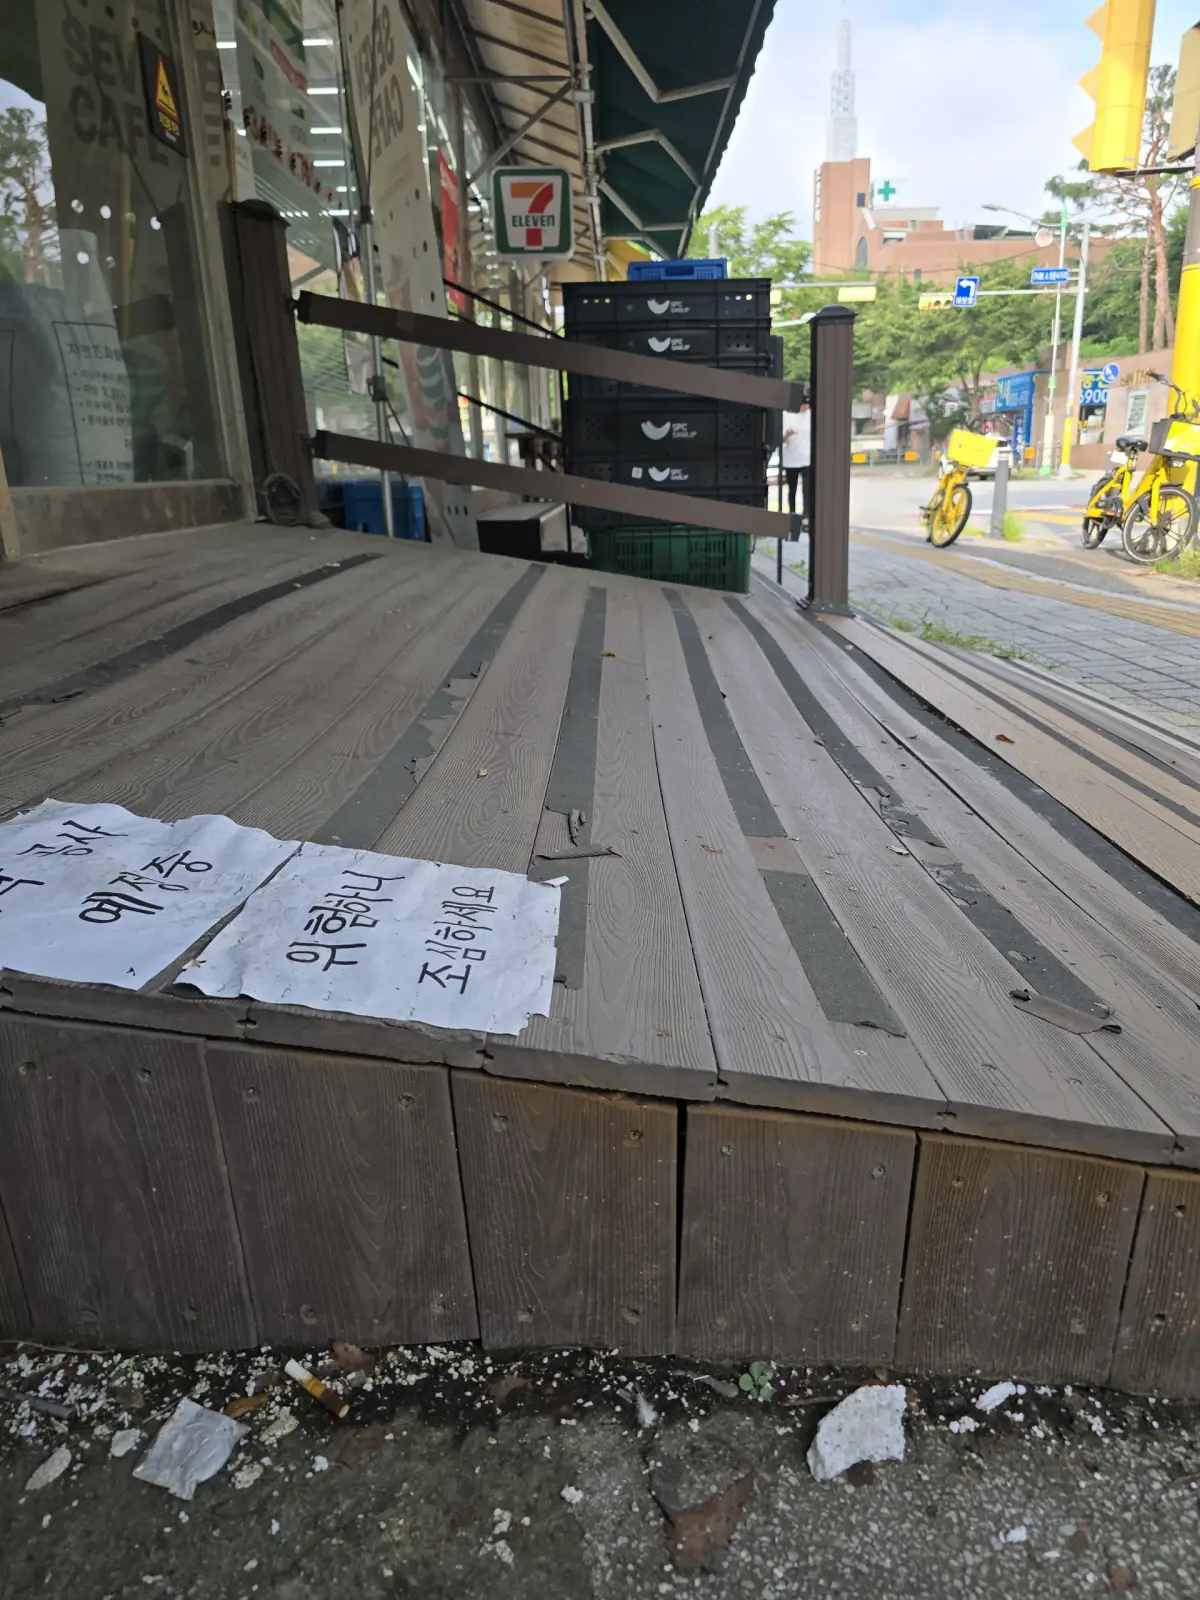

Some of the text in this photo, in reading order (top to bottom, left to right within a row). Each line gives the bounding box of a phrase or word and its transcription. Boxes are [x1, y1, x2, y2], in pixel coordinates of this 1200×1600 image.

[62, 15, 138, 94] SEV
[16, 820, 129, 857] 공사
[79, 850, 213, 924] 예정중
[286, 870, 406, 972] 위험하니
[418, 886, 498, 995] 조심하세요
